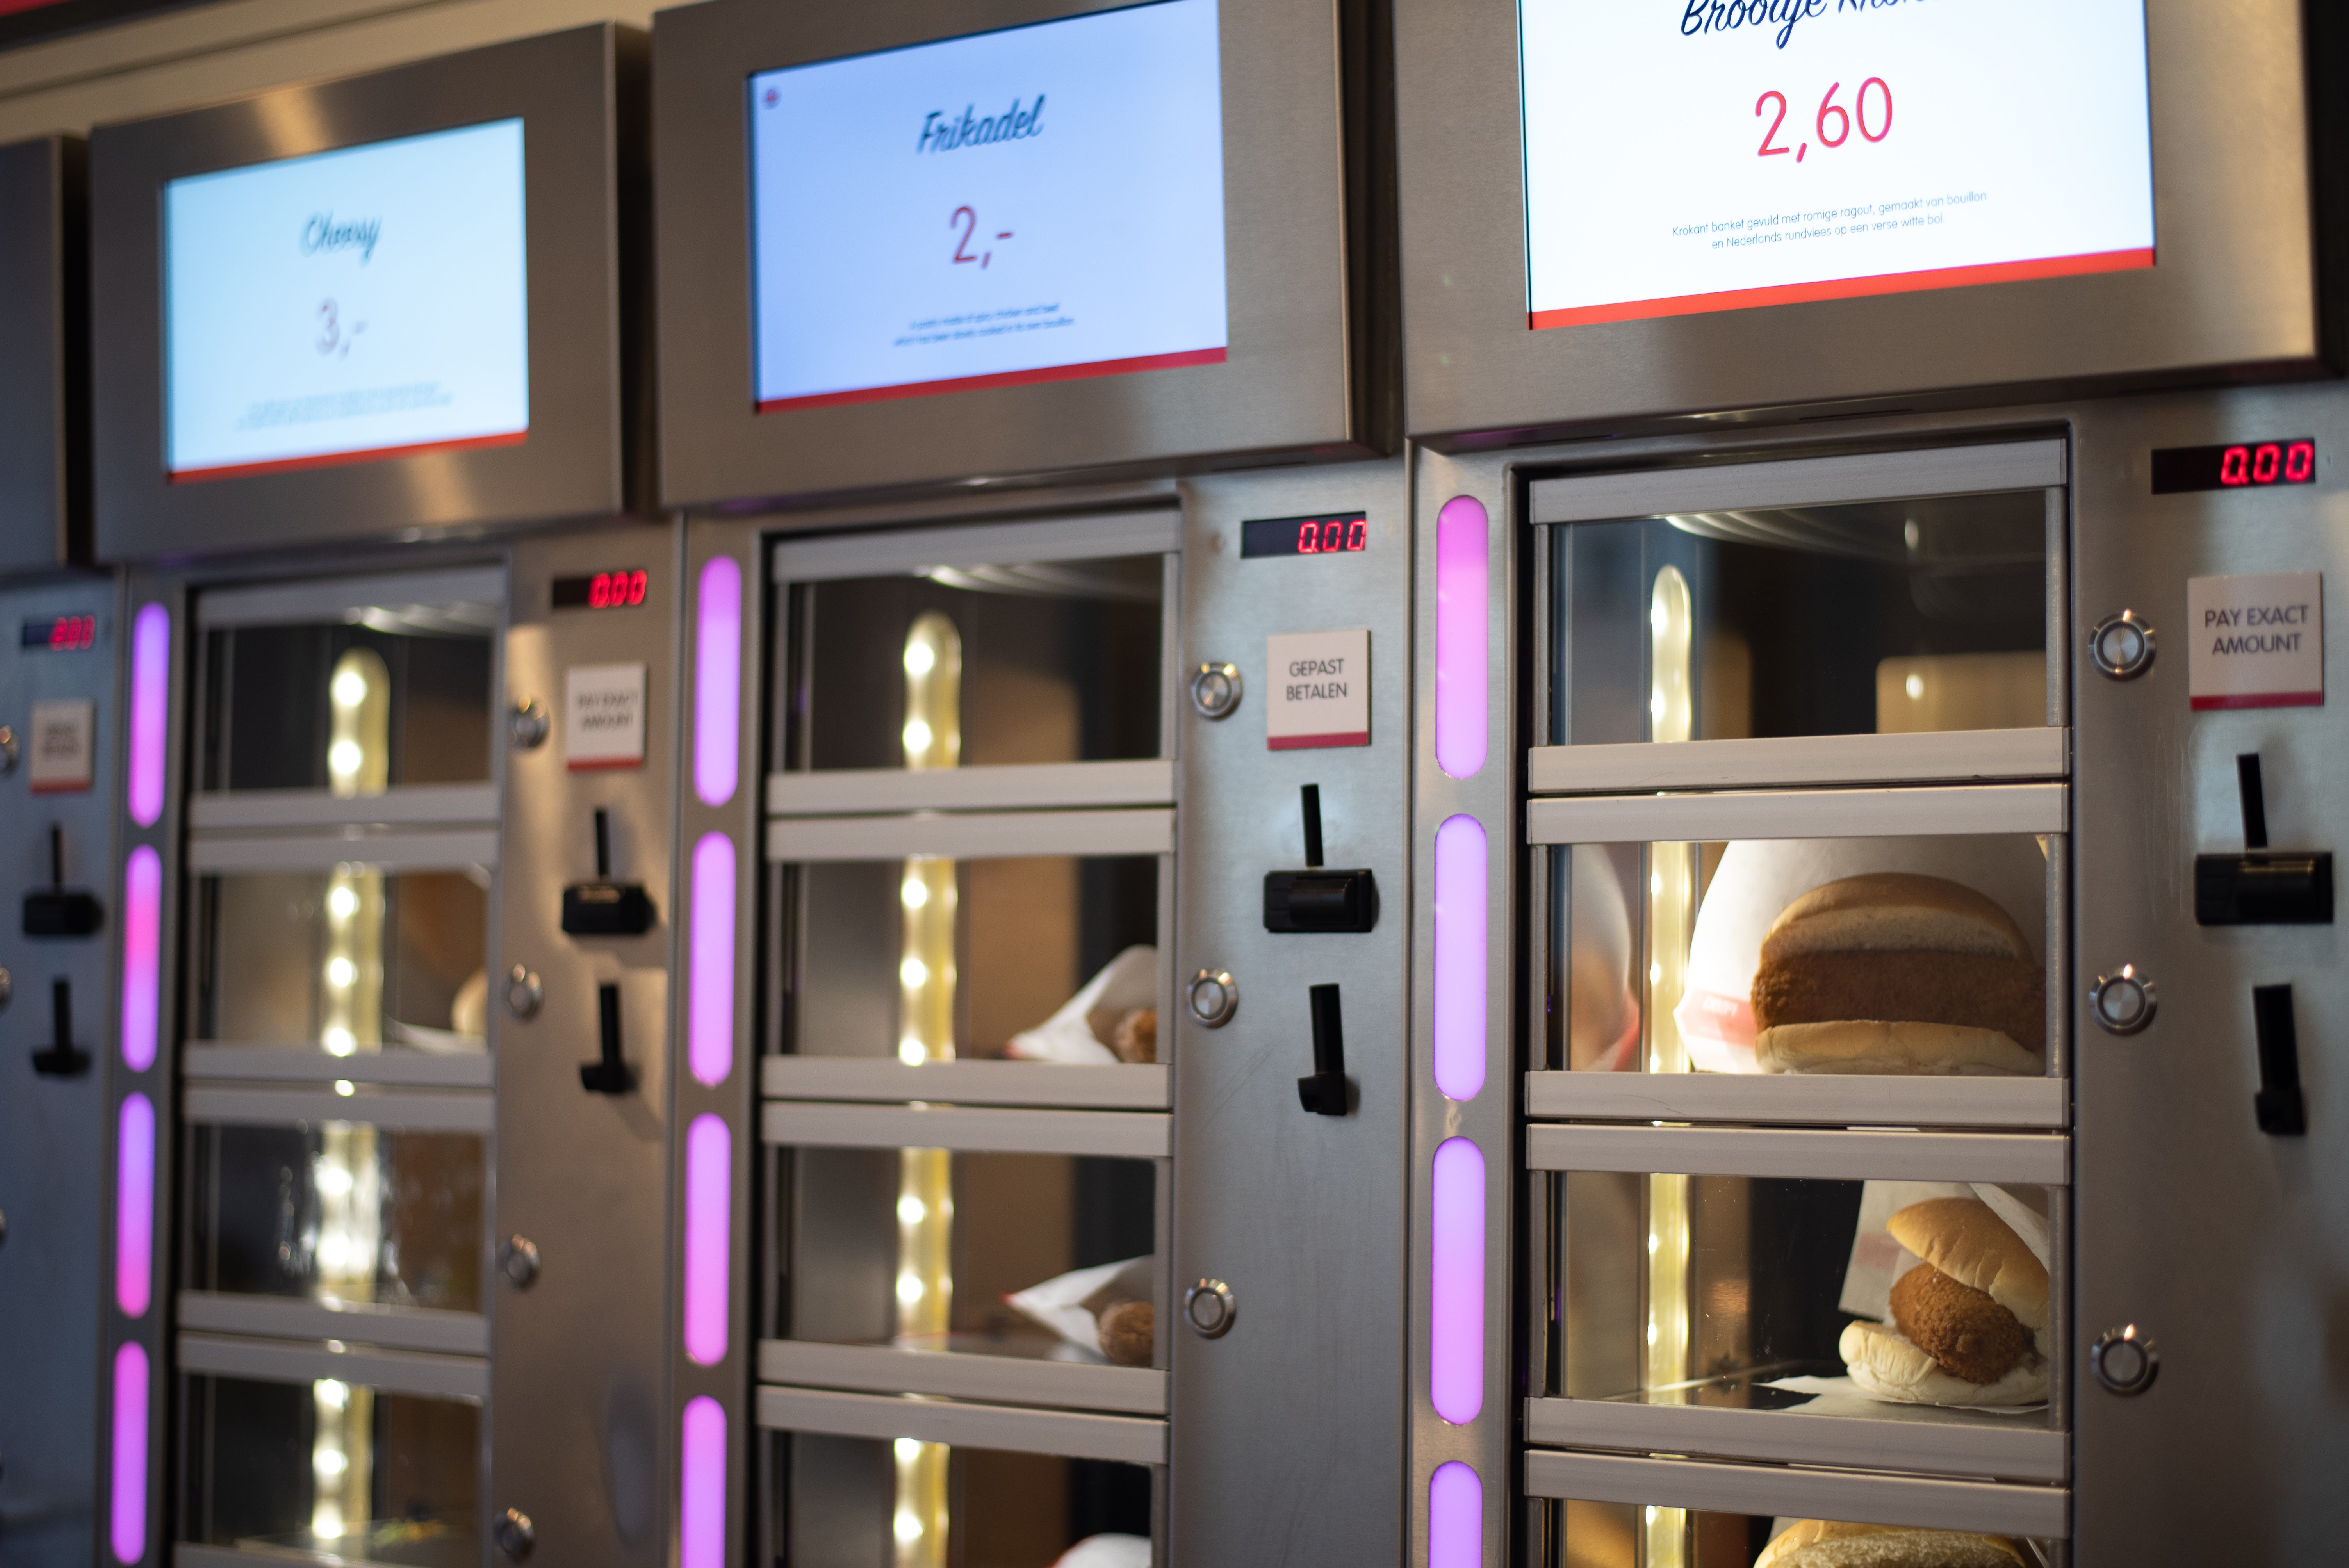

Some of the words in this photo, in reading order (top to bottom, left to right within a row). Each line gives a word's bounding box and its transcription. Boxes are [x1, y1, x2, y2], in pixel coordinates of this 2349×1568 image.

[917, 94, 1046, 153] Frikadel
[1755, 77, 1893, 163] 2,60
[1672, 223, 1709, 237] Krokant
[1711, 219, 1744, 232] banket
[1747, 214, 1779, 231] gevuld
[1782, 212, 1800, 224] met
[1803, 209, 1837, 222] romige
[1840, 204, 1875, 219] ragout,
[1878, 198, 1923, 216] gemaakt
[1925, 197, 1943, 207] van
[1947, 191, 1987, 205] bouillon
[949, 204, 1014, 270] 2,-
[1712, 239, 1723, 249] en
[1726, 230, 1782, 247] Nederlands
[1785, 227, 1832, 241] rundvlees
[1834, 226, 1847, 237] op
[1850, 223, 1868, 233] een
[1871, 220, 1898, 230] verse
[1901, 216, 1925, 228] witte
[2221, 441, 2314, 485] 0.00
[1297, 519, 1367, 553] 0.00
[2205, 609, 2240, 628] PAY
[2247, 605, 2308, 625] EXACT
[2212, 633, 2301, 655] AMOUNT
[1289, 658, 1344, 677] GEPAST
[1287, 682, 1347, 701] BETALEN
